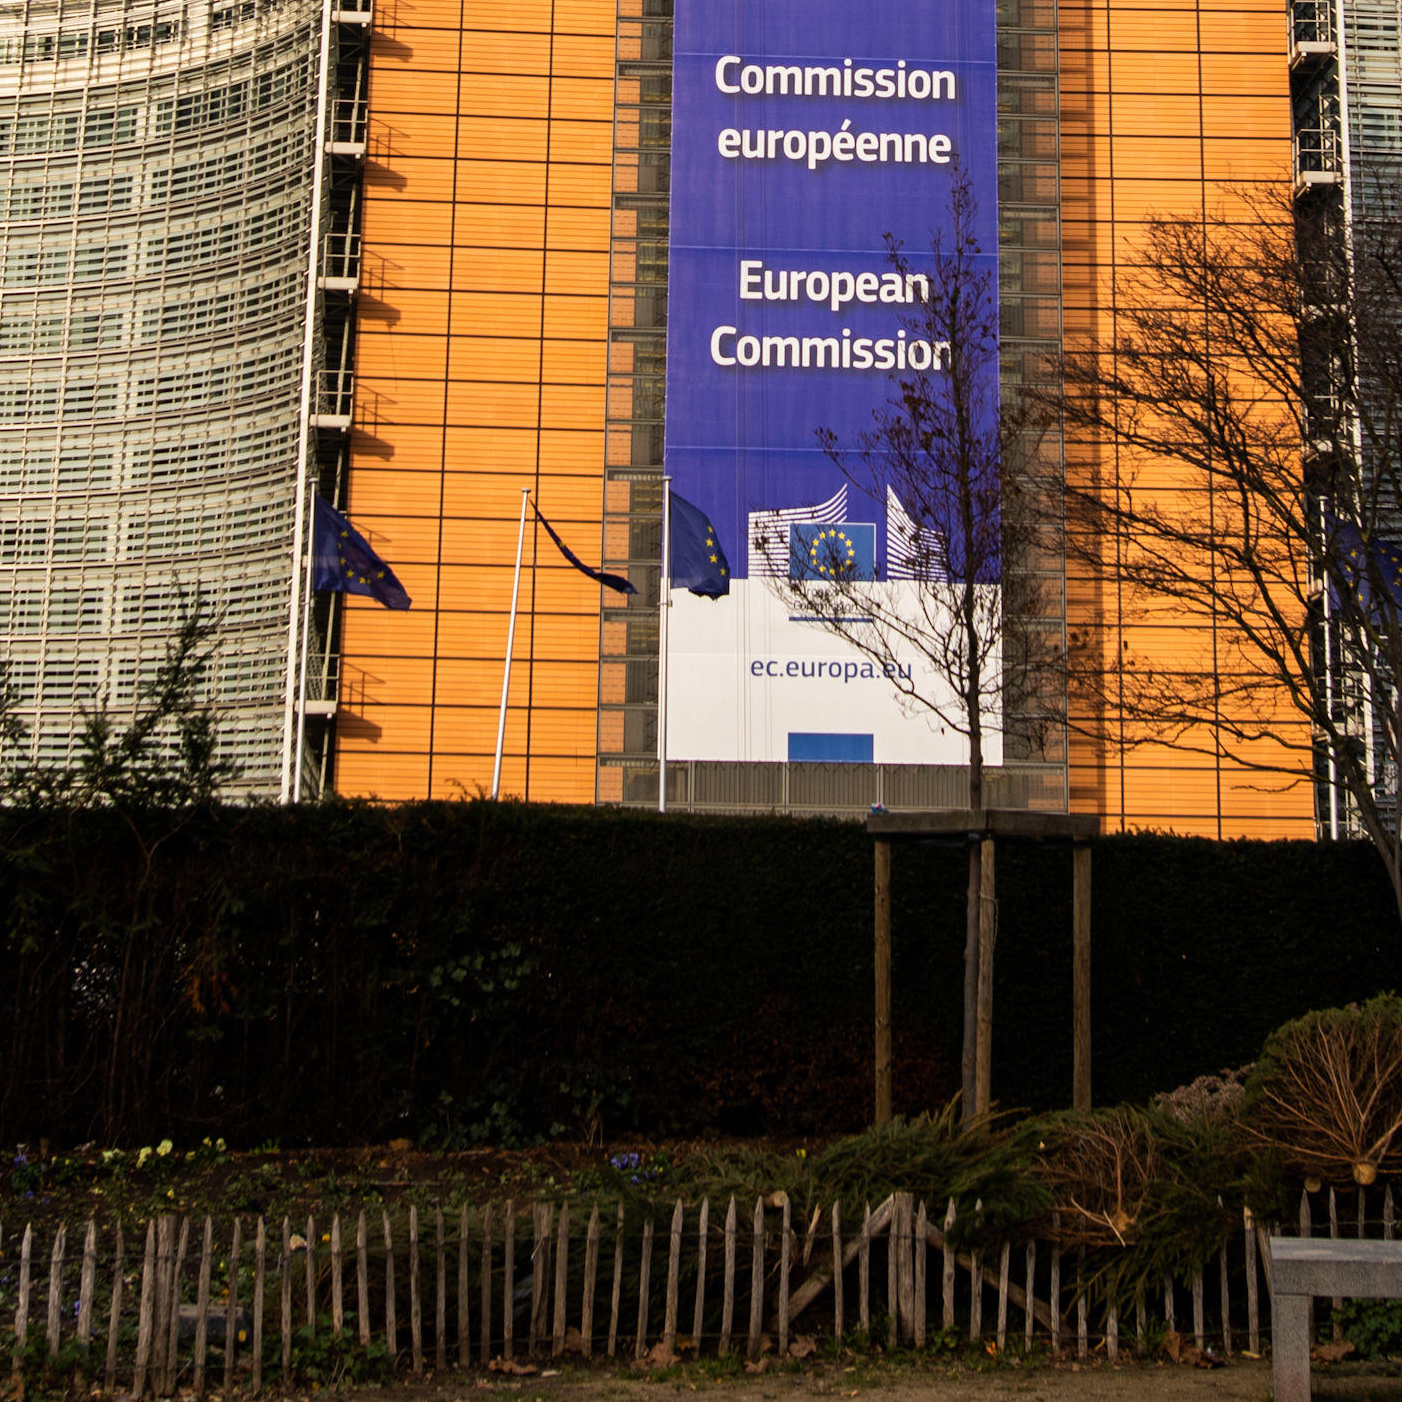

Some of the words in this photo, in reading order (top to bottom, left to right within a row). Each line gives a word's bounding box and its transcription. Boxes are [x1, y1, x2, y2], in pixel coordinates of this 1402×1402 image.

[715, 55, 956, 99] Commission
[717, 118, 952, 170] européenne
[739, 260, 930, 311] European
[710, 325, 952, 371] Commission
[750, 659, 912, 684] ec.europa.eu
